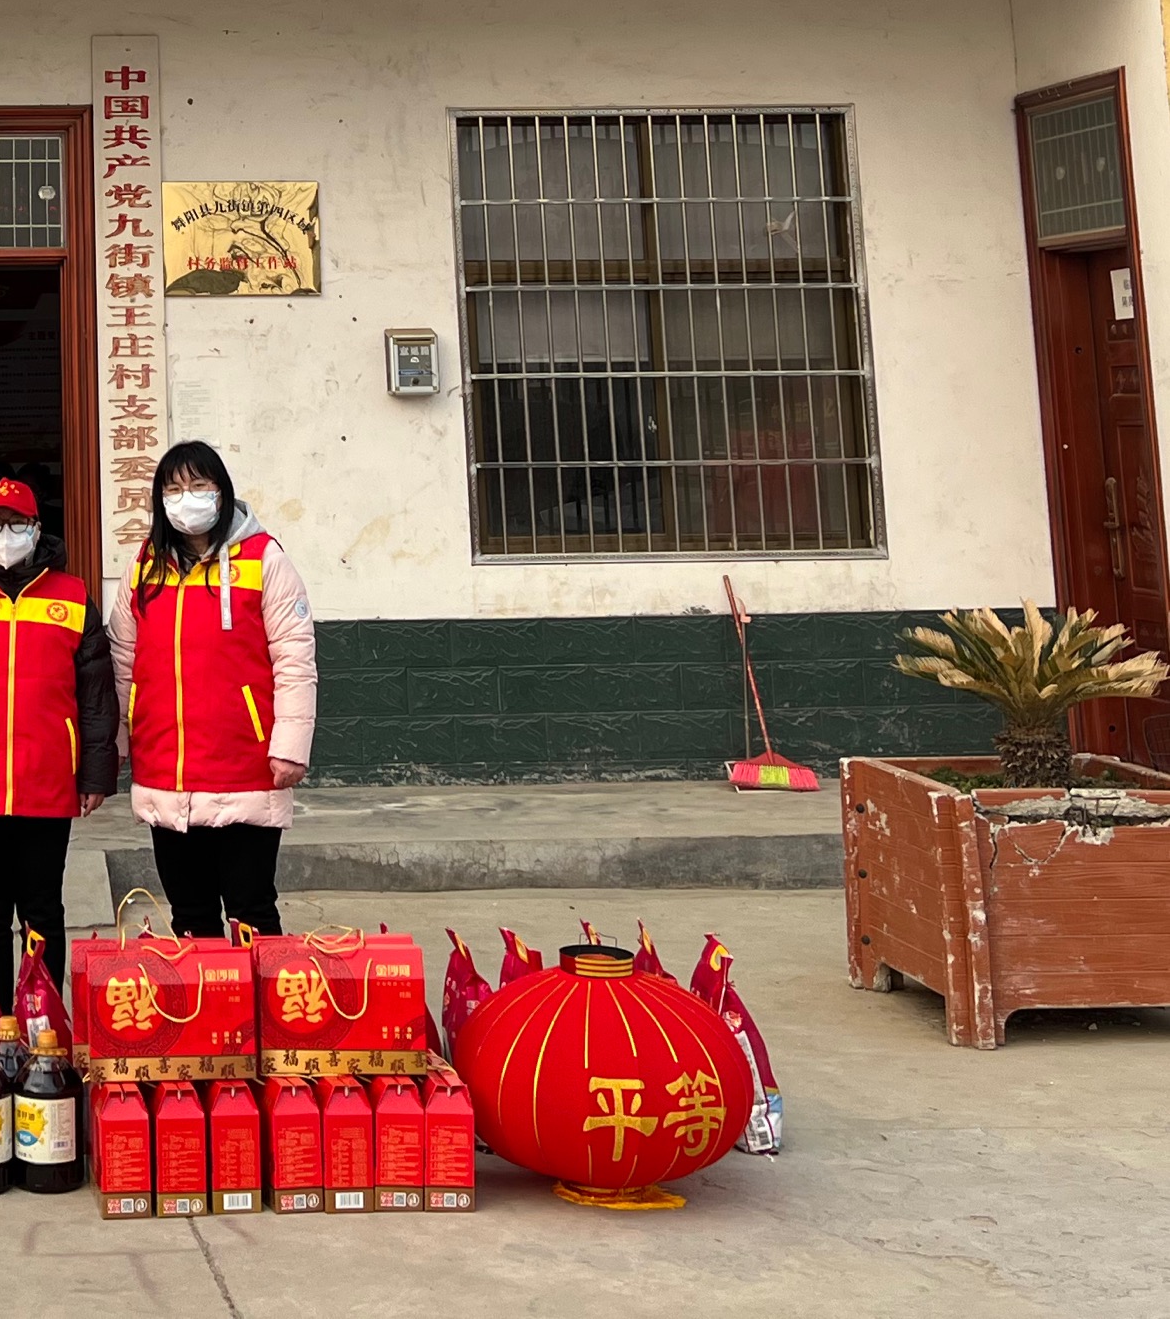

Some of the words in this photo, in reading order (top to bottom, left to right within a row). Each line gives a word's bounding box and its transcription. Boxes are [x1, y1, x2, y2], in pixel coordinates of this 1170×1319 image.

[187, 256, 298, 271] 村务监督工作站
[102, 65, 158, 545] 中国共产党九街镇王庄村支部委员会
[106, 976, 158, 1031] 福
[276, 968, 328, 1023] 福
[582, 1070, 727, 1162] 平等
